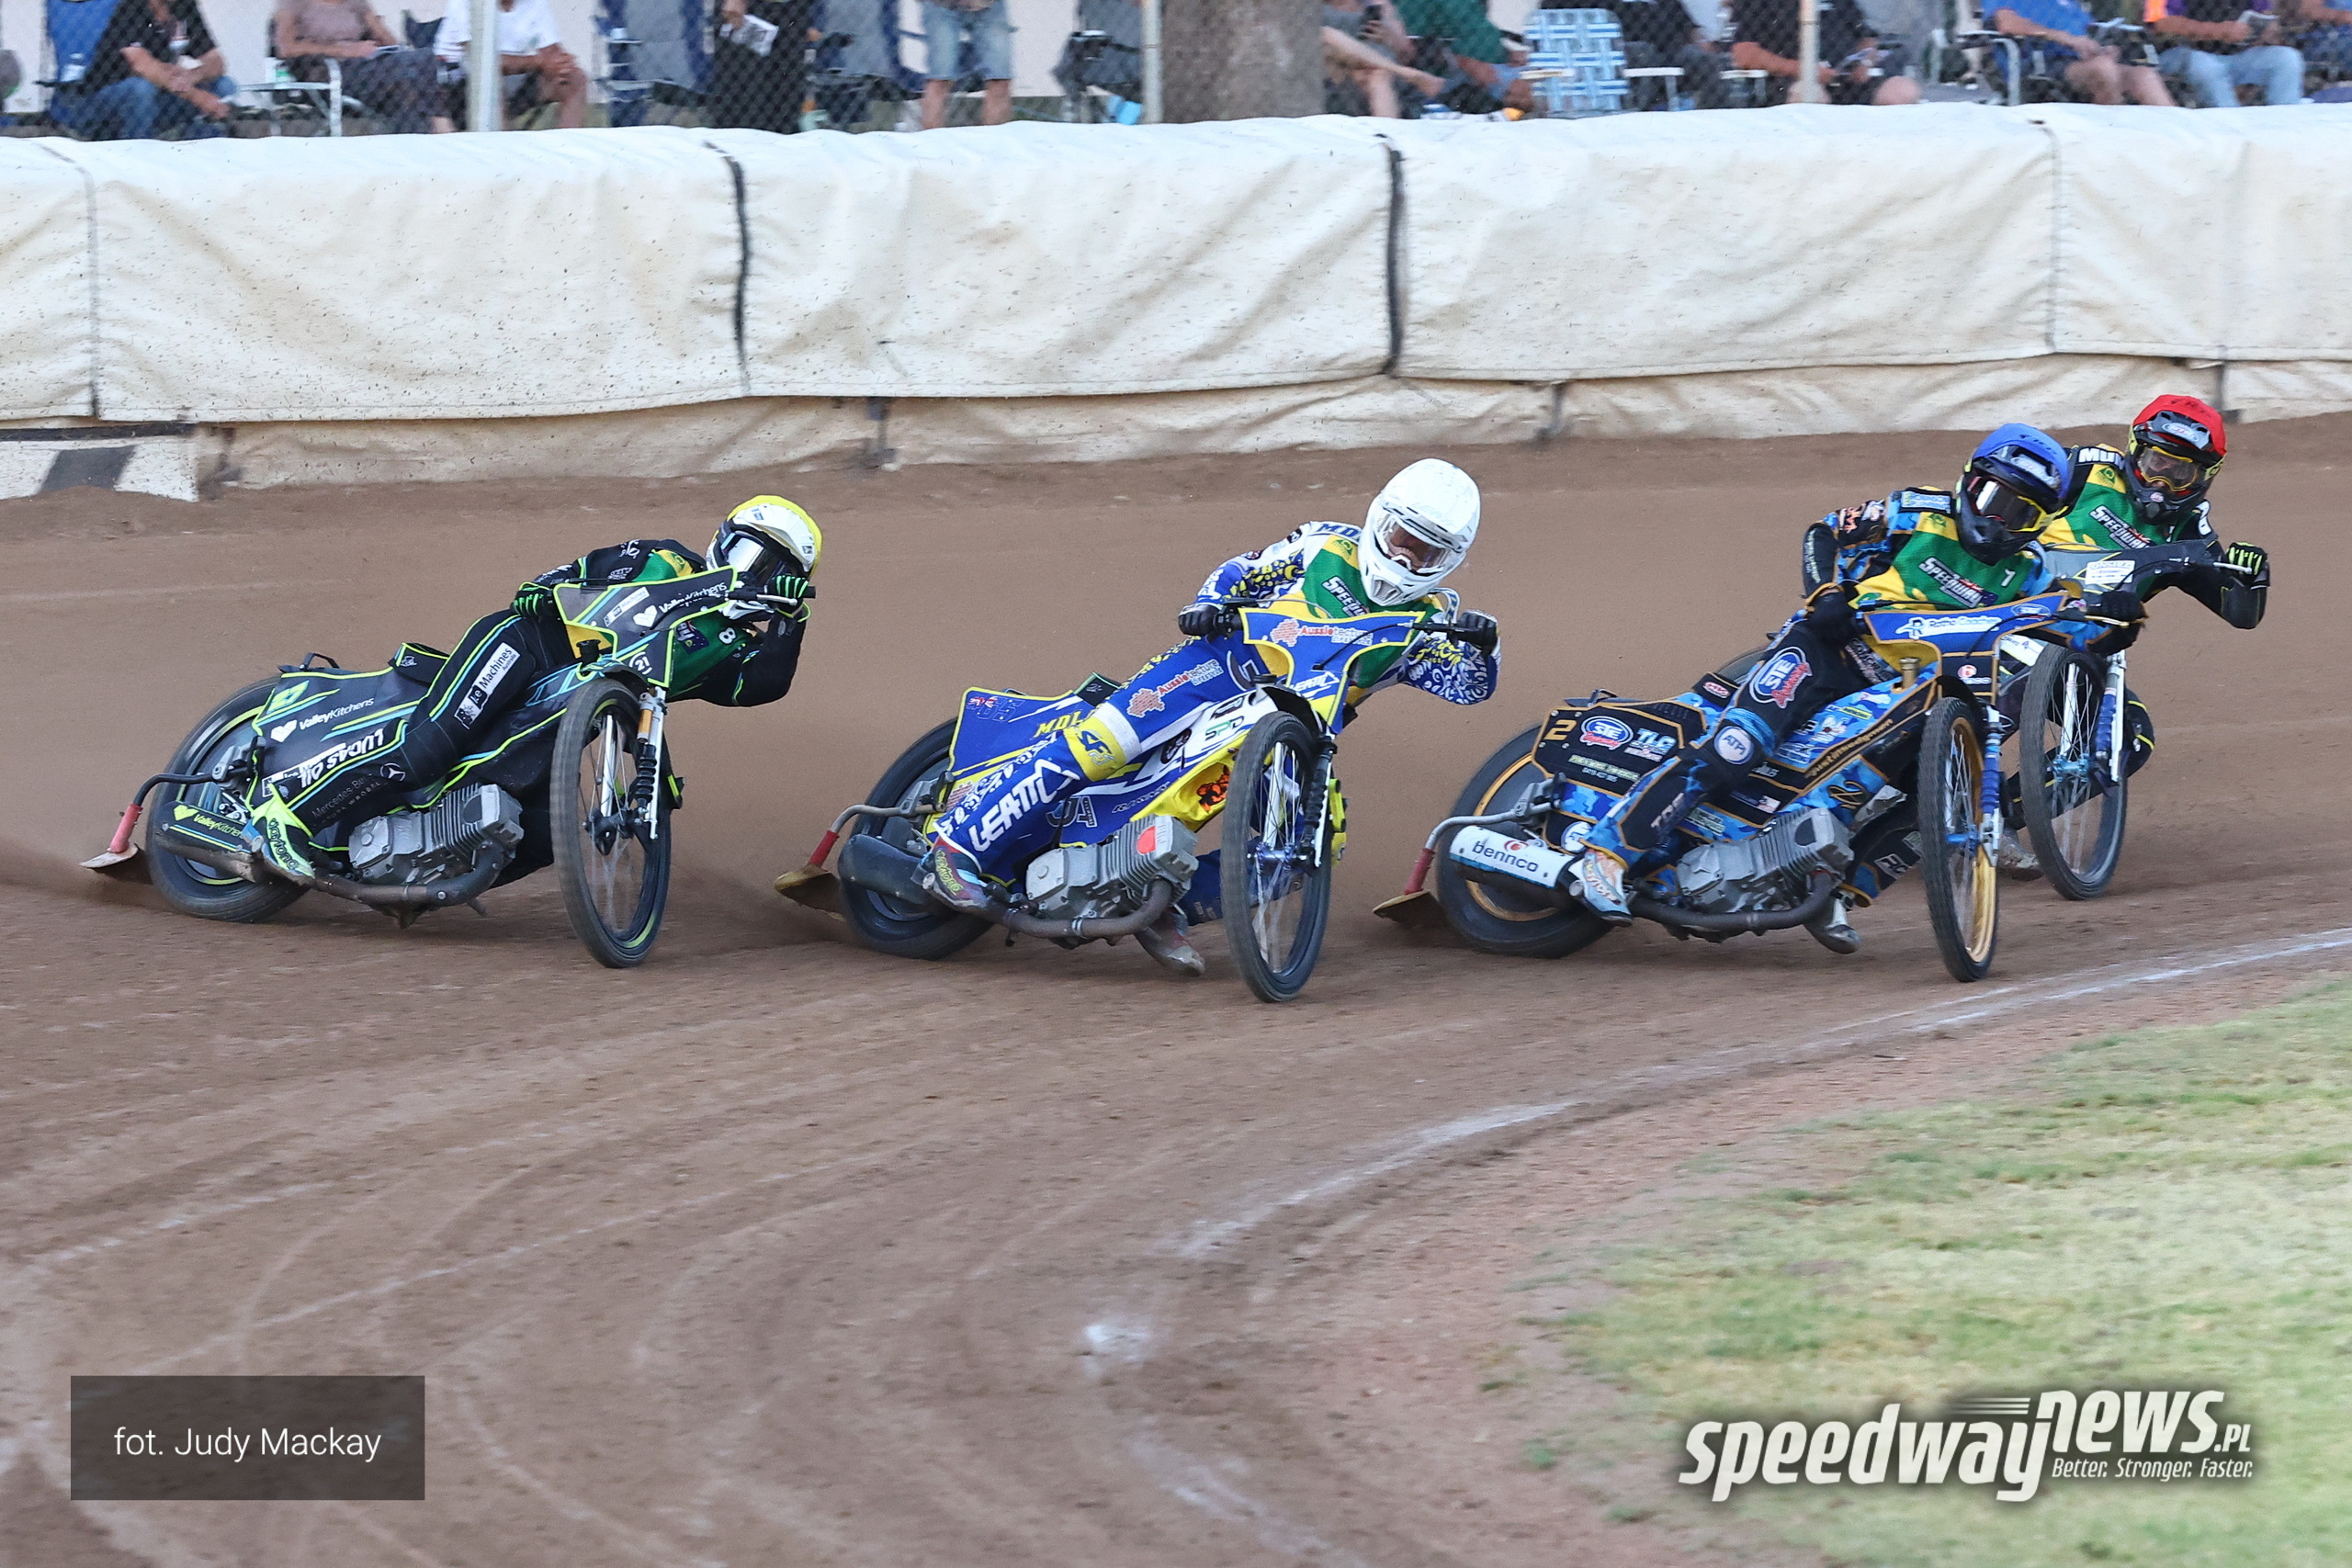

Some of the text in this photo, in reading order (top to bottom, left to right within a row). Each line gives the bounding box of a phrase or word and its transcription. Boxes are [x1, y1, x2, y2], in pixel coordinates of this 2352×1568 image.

[718, 626, 737, 645] 8
[479, 648, 513, 689] Machines
[299, 697, 375, 731] ValleyKitchens
[1544, 719, 1577, 740] 2
[1472, 840, 1539, 873] bennco
